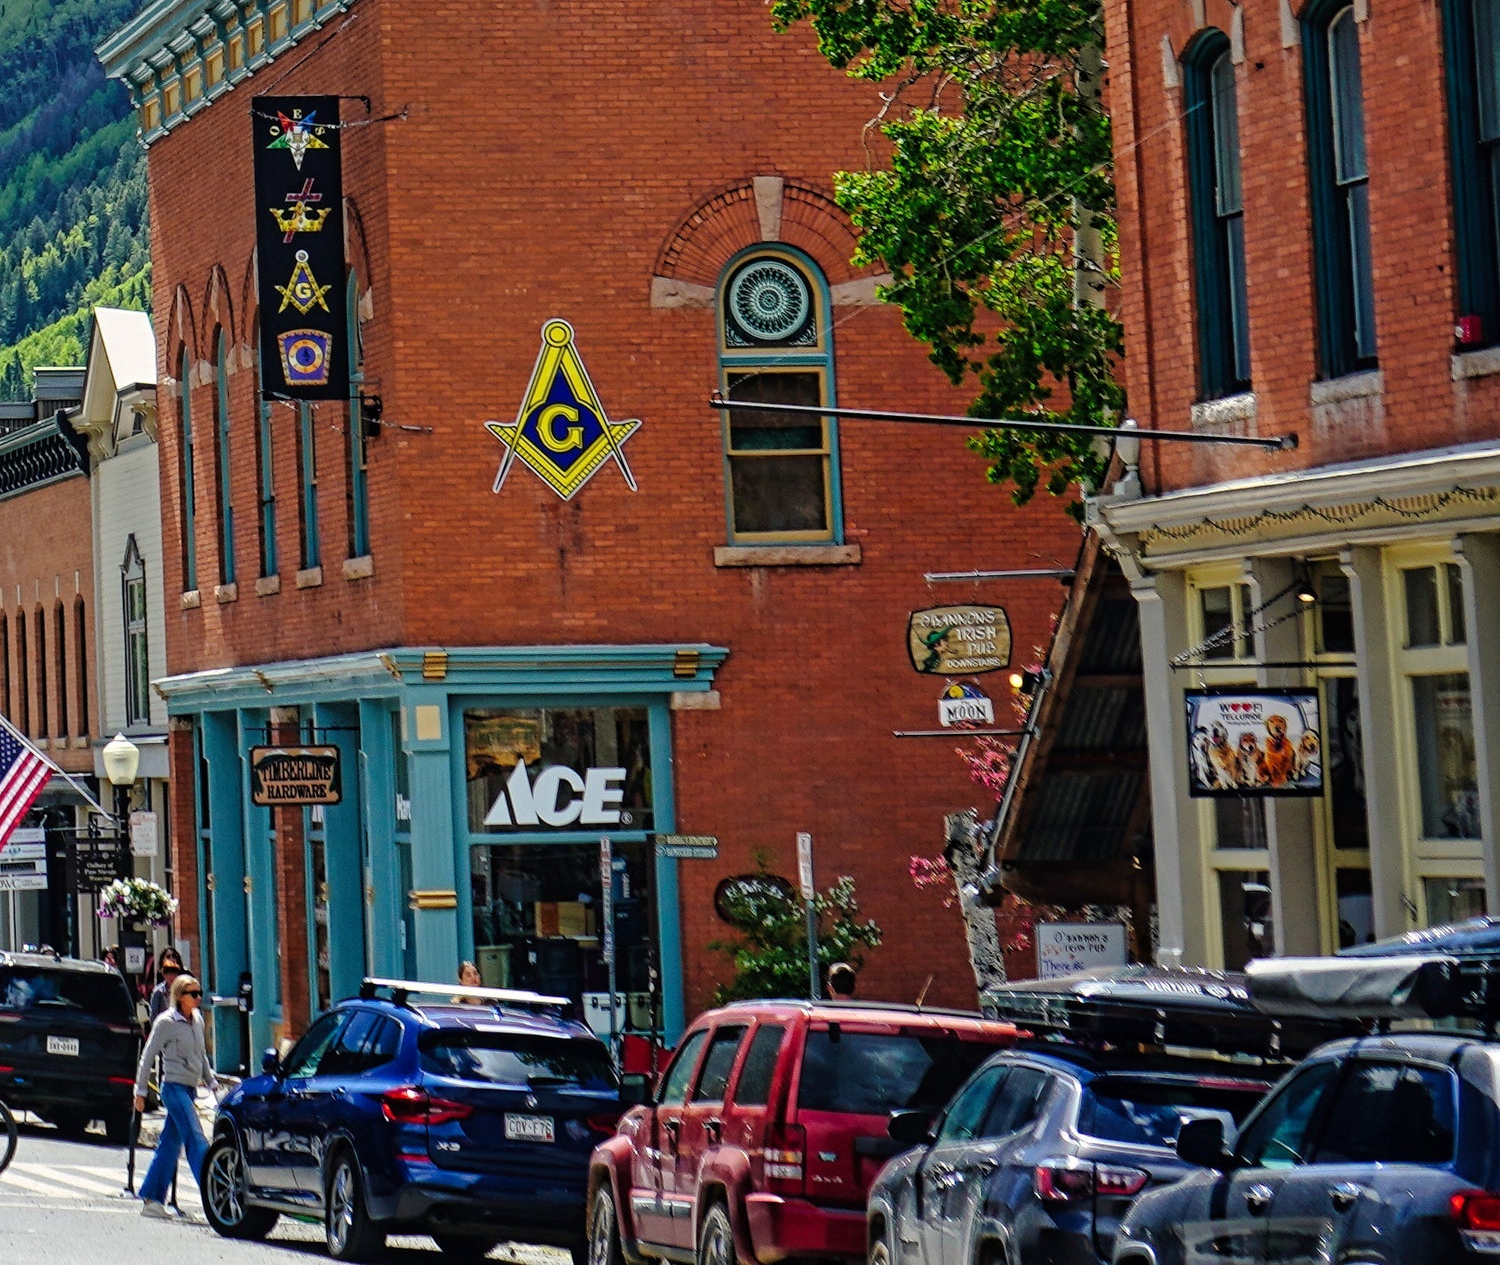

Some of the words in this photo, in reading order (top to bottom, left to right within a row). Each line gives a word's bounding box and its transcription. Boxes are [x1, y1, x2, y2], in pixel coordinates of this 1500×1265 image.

[295, 282, 312, 299] G
[535, 403, 585, 453] G
[955, 625, 997, 641] IRISH
[967, 641, 997, 655] PUB
[946, 656, 1001, 669] DOWNSTAIRS
[947, 704, 986, 721] MOON
[261, 759, 332, 782] TIMBERLINE
[267, 784, 327, 799] HARDWARE
[483, 757, 627, 826] ACE
[1143, 979, 1202, 995] VENTURE
